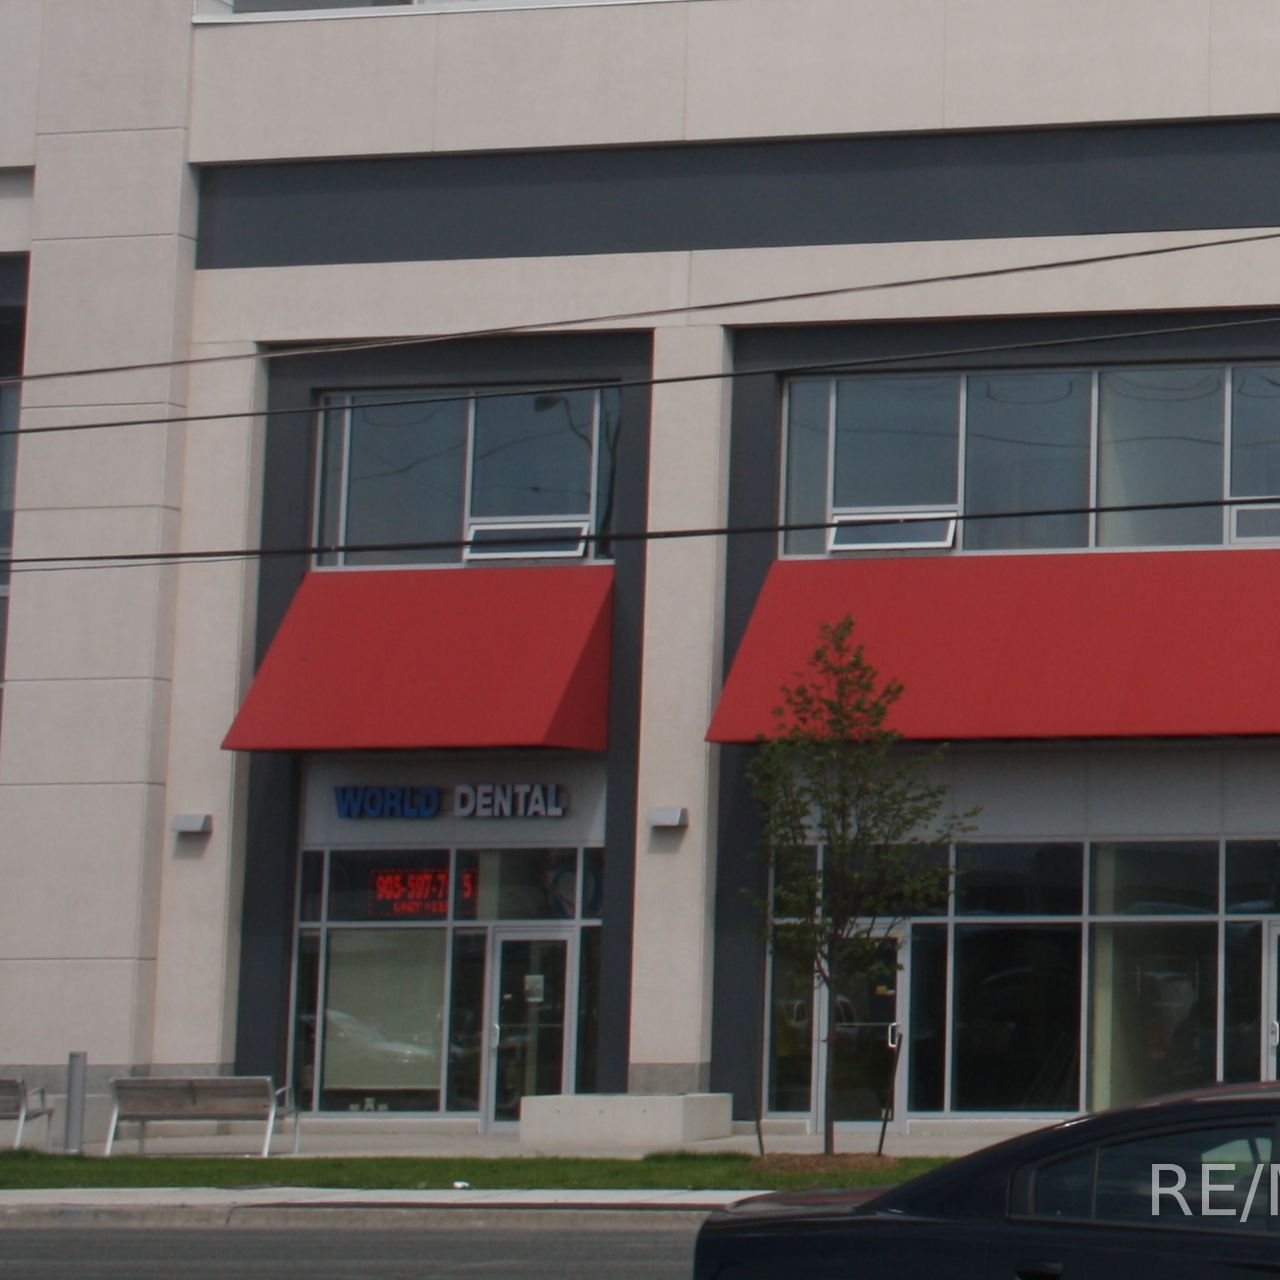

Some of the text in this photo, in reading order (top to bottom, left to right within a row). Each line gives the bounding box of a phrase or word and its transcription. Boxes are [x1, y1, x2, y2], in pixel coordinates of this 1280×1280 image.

[334, 784, 563, 818] WORLD DENTAL
[376, 873, 473, 900] 905-597-75
